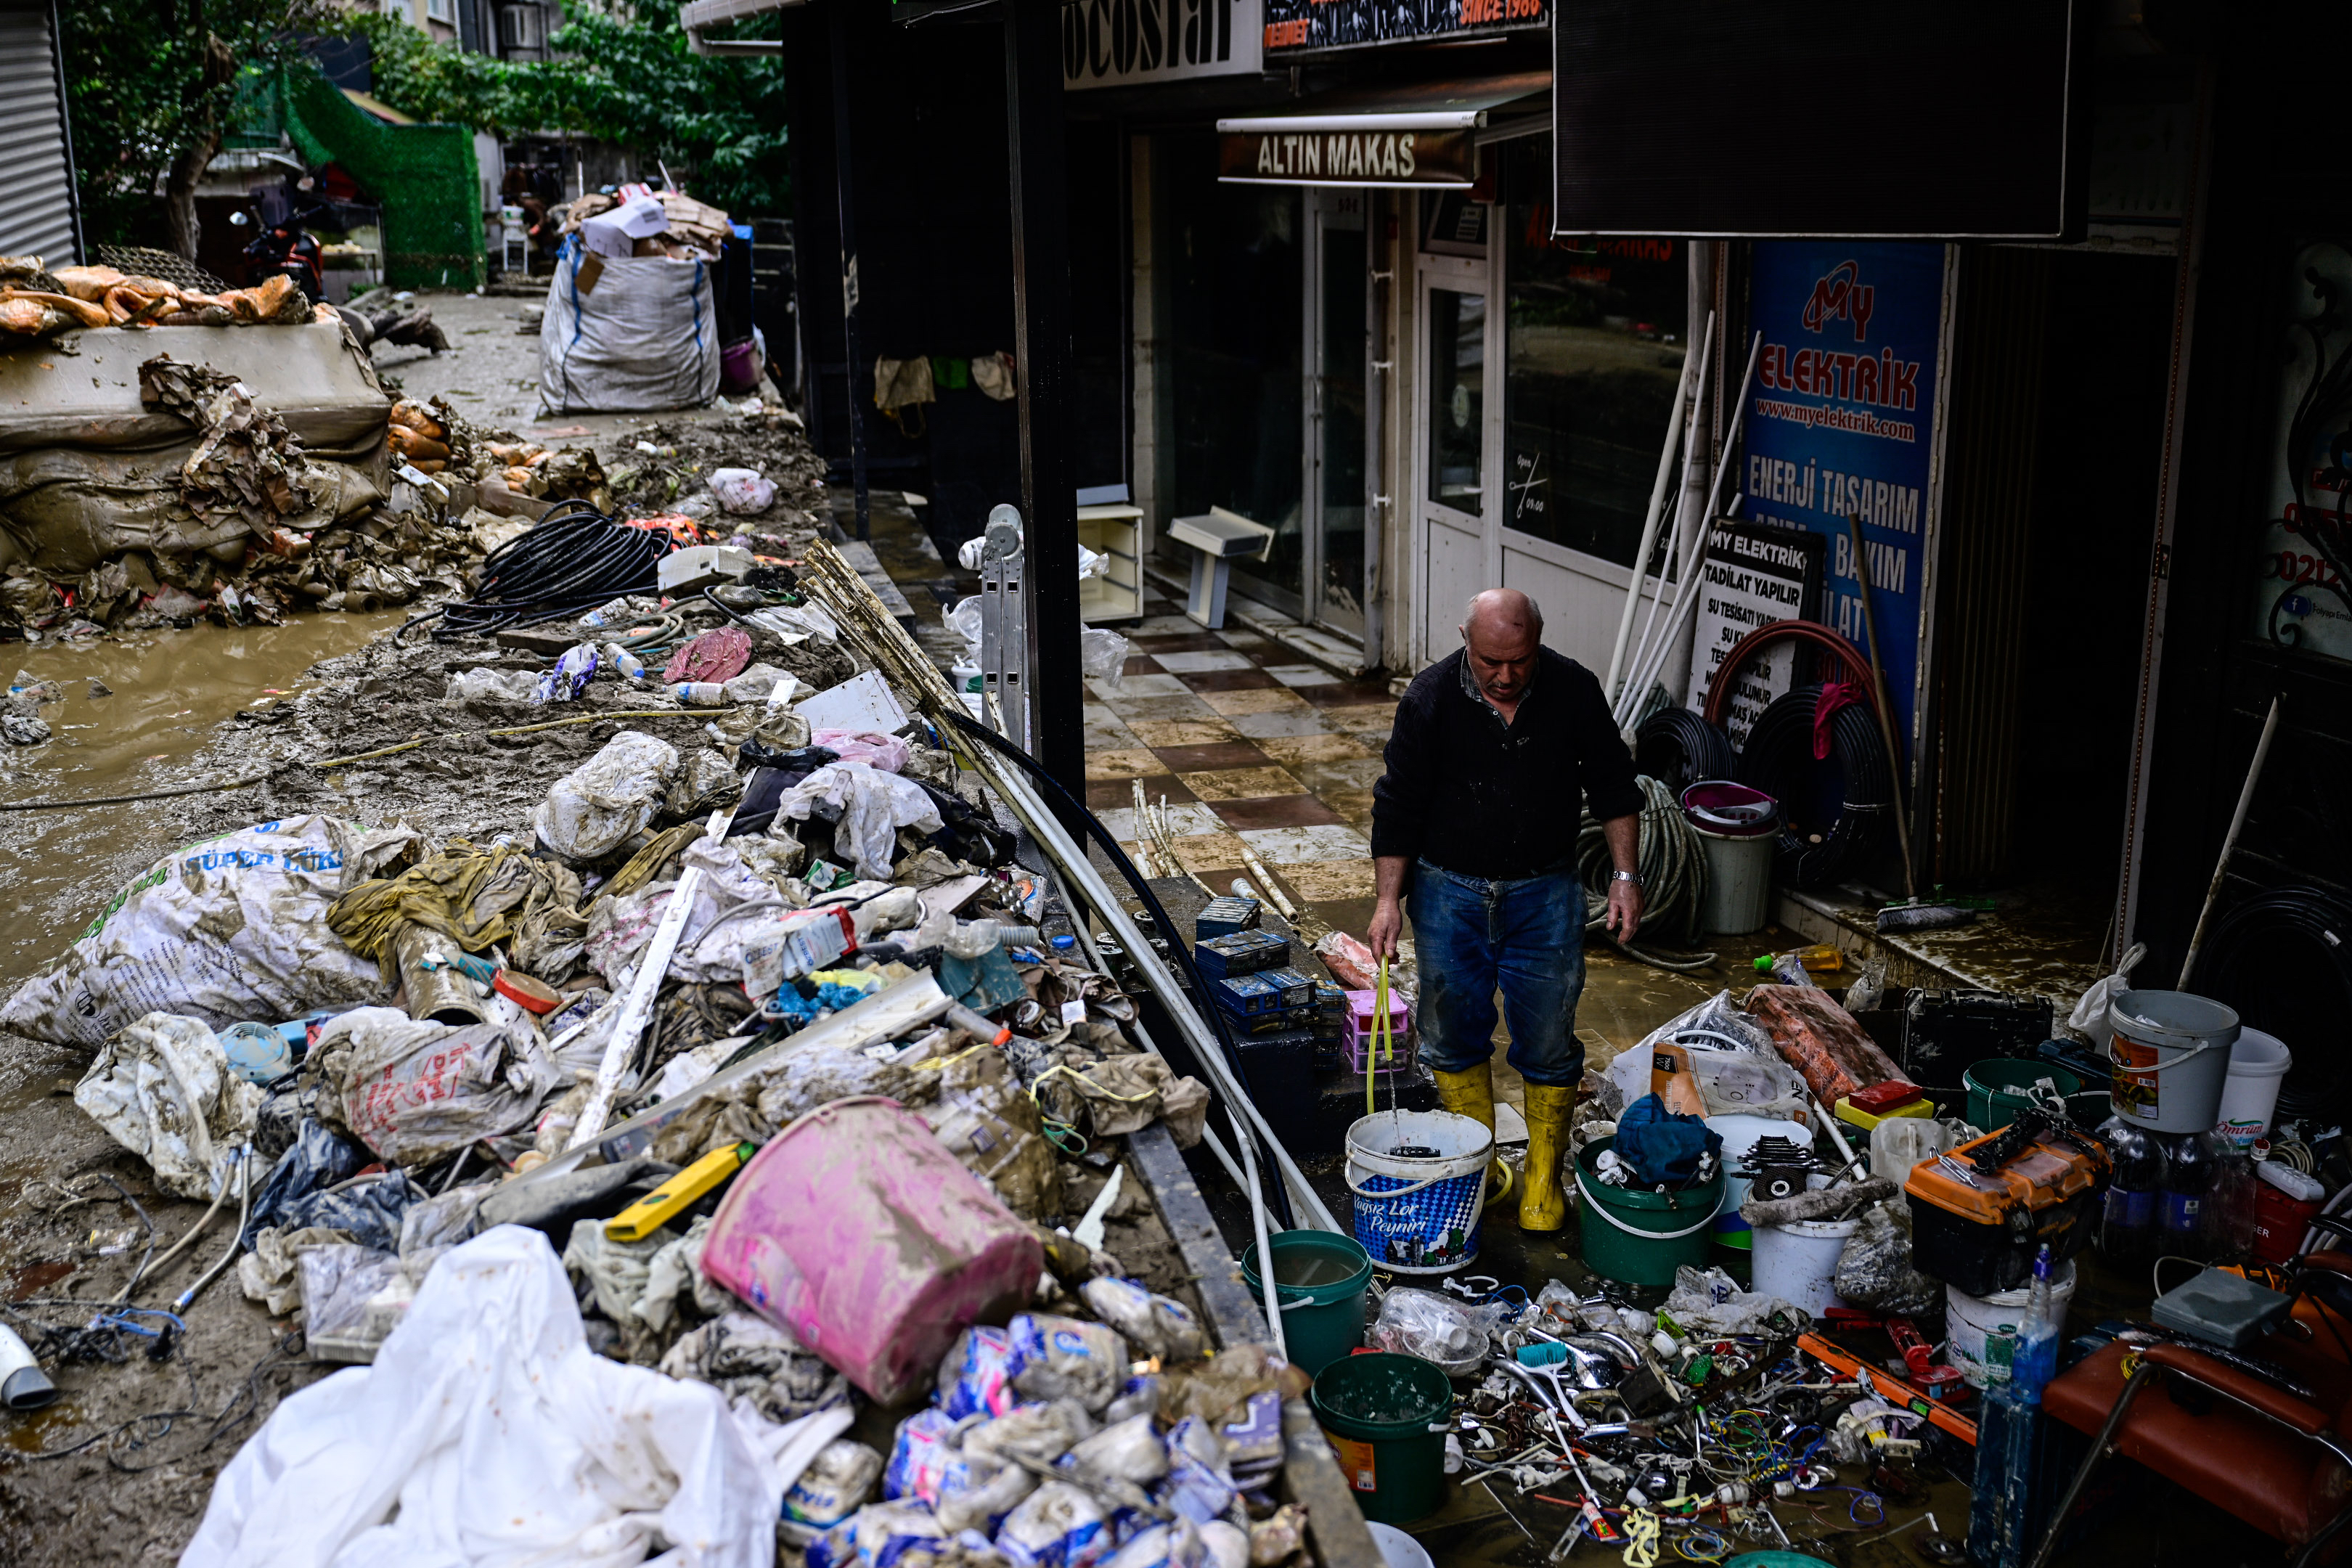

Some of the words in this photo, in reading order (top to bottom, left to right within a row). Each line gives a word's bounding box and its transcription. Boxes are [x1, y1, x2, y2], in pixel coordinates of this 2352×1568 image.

[1460, 0, 1504, 25] SINCE
[1257, 134, 1320, 175] ALTIN
[1327, 133, 1415, 177] MAKAS
[1809, 274, 1874, 343] MY
[1757, 343, 1920, 412] ELEKTRİK
[1755, 398, 1915, 444] www.myelektrik.com
[1517, 453, 1532, 470] Open
[1526, 497, 1543, 513] 09:00
[1749, 454, 1816, 510] ENERJİ
[1822, 469, 1919, 534] TASARIM
[1710, 528, 1732, 550] MY
[1734, 536, 1805, 570] ELEKTRİK
[2279, 551, 2341, 588] 0212
[1704, 564, 1752, 593] TADİLAT
[1754, 577, 1800, 607] YAPILIR
[1707, 598, 1719, 615] SU
[1720, 601, 1755, 625] TESİSATI
[1721, 627, 1733, 643] SU
[186, 849, 274, 875] SÜPER
[2217, 1120, 2263, 1135] Ömrüm
[1354, 1193, 1385, 1217] Yağsız
[1389, 1200, 1421, 1217] Lor
[1370, 1216, 1427, 1238] Peyniri
